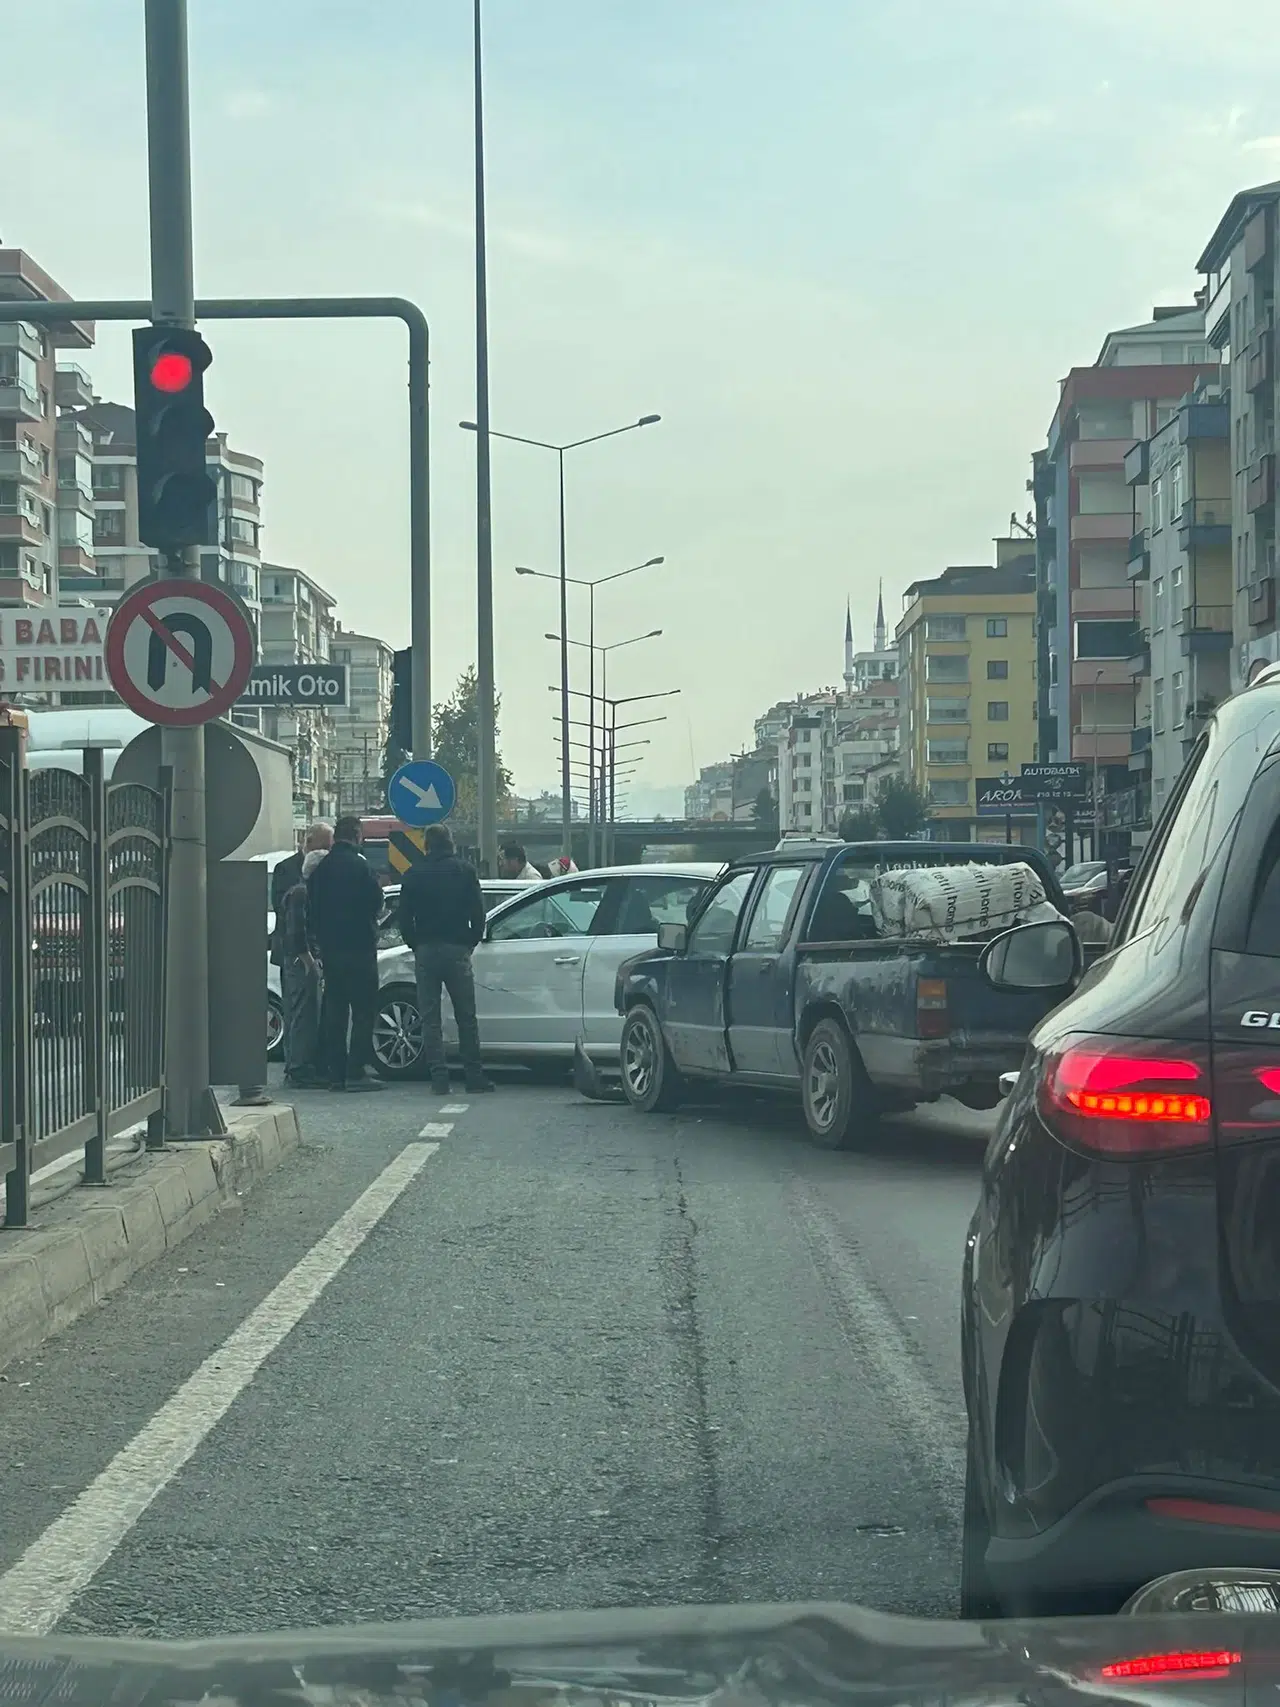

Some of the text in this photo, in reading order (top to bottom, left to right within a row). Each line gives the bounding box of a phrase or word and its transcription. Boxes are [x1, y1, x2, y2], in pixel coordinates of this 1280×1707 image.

[15, 618, 102, 644] BABA
[15, 655, 103, 681] FIRINI
[297, 674, 340, 696] Oto
[1023, 767, 1080, 776] AUTOBANK
